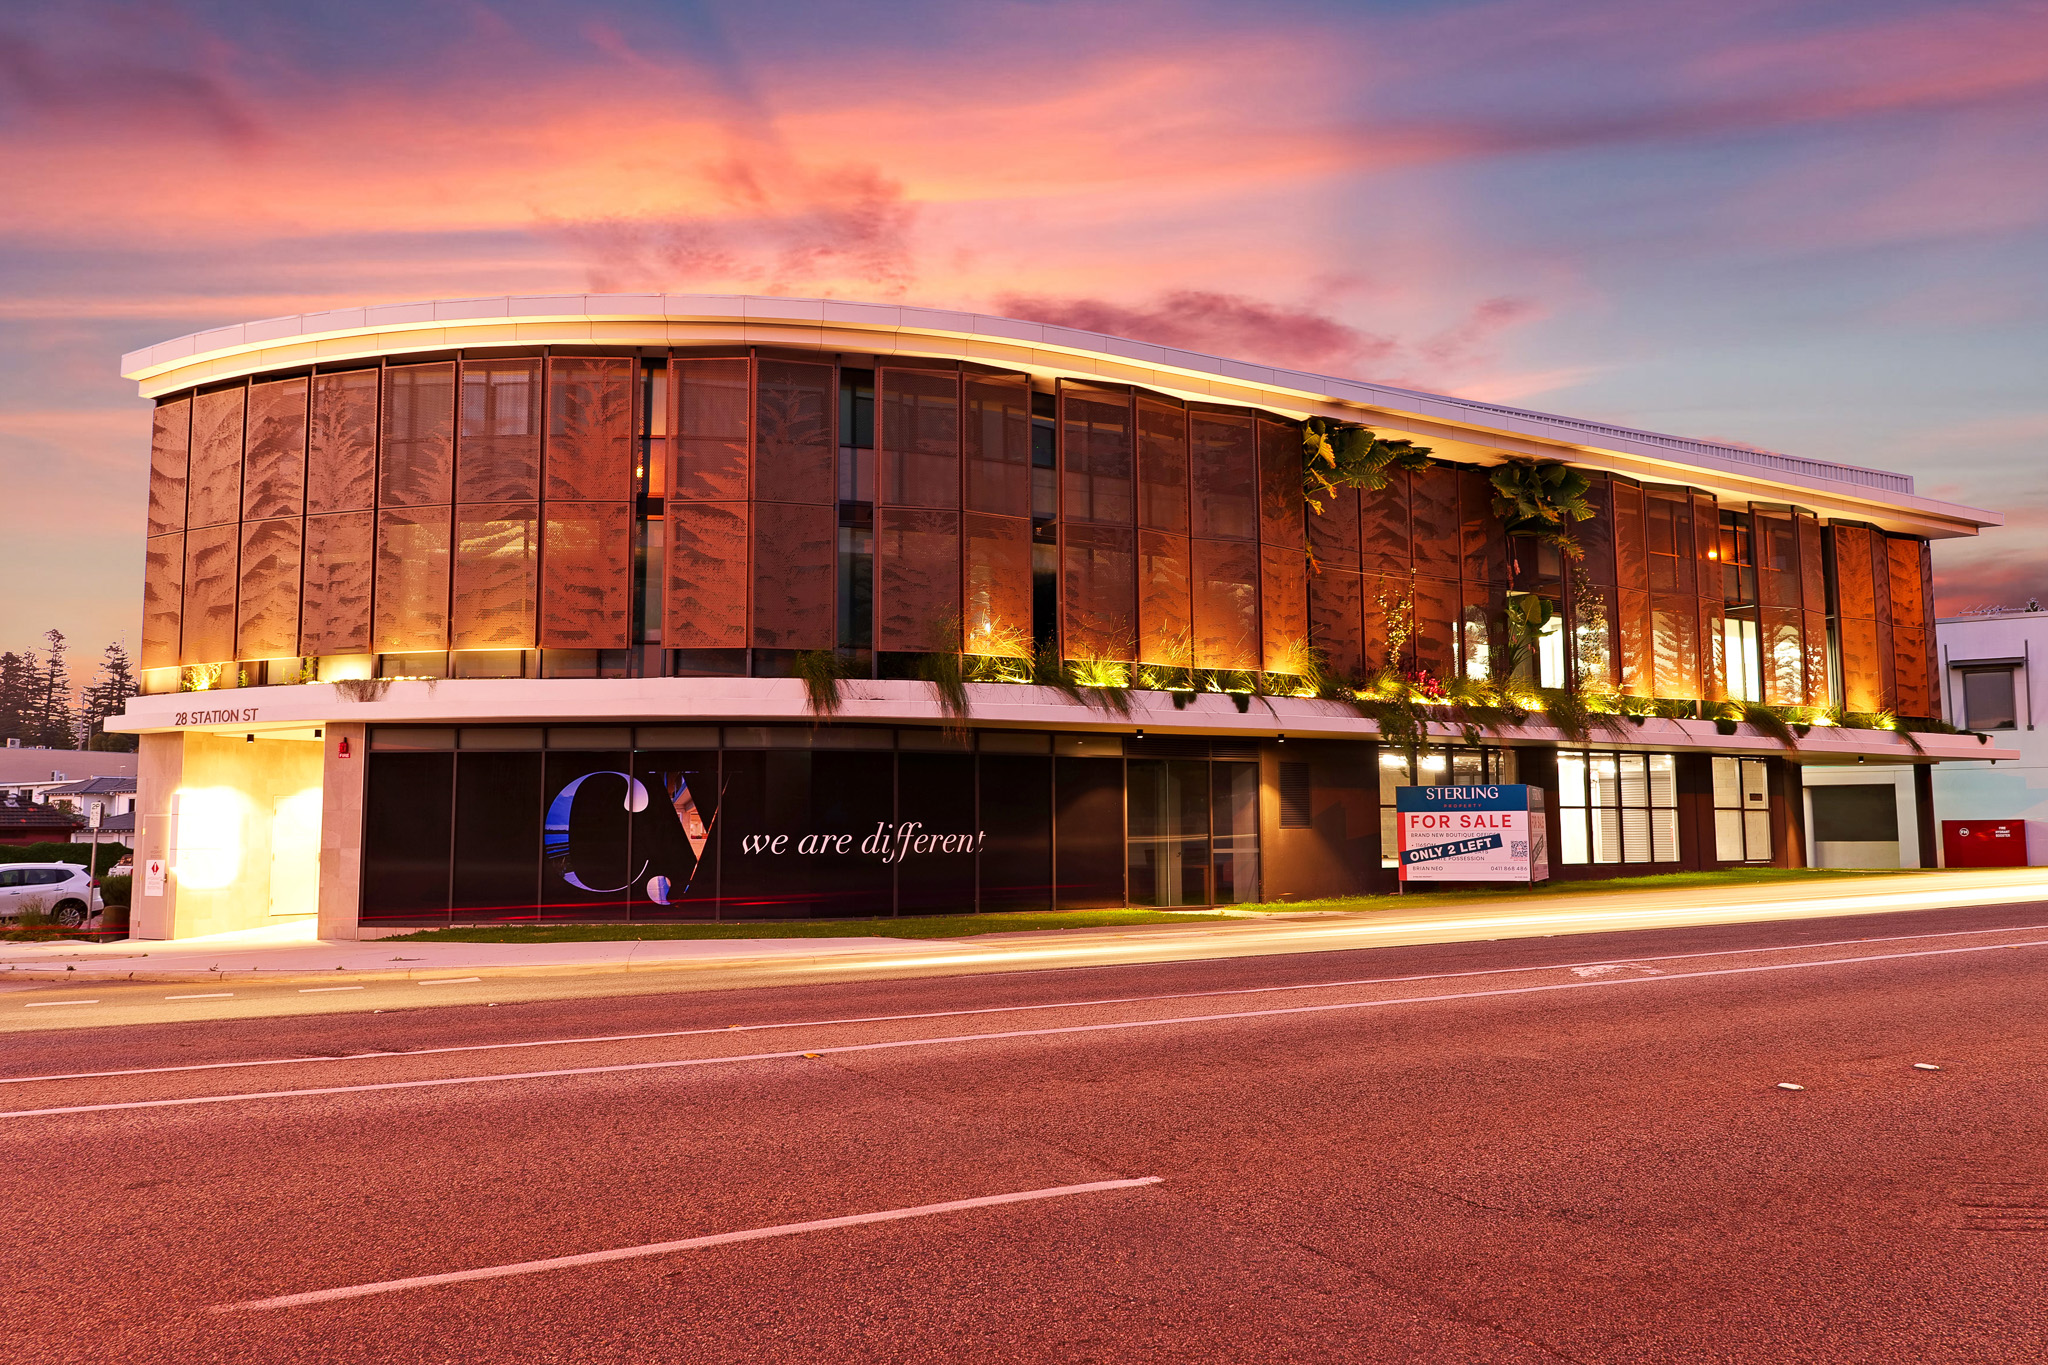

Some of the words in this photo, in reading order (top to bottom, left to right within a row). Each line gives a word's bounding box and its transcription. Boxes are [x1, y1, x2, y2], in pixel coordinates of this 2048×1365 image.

[175, 712, 188, 726] 28
[191, 709, 239, 724] STATION
[243, 708, 259, 721] ST
[1426, 786, 1499, 800] STERLING
[1411, 814, 1450, 828] FOR
[1460, 814, 1512, 828] SALE
[742, 833, 790, 855] we
[798, 833, 853, 855] are
[861, 820, 987, 864] different
[1409, 846, 1443, 861] ONLY
[1447, 845, 1456, 855] 2
[1459, 838, 1492, 853] LEFT
